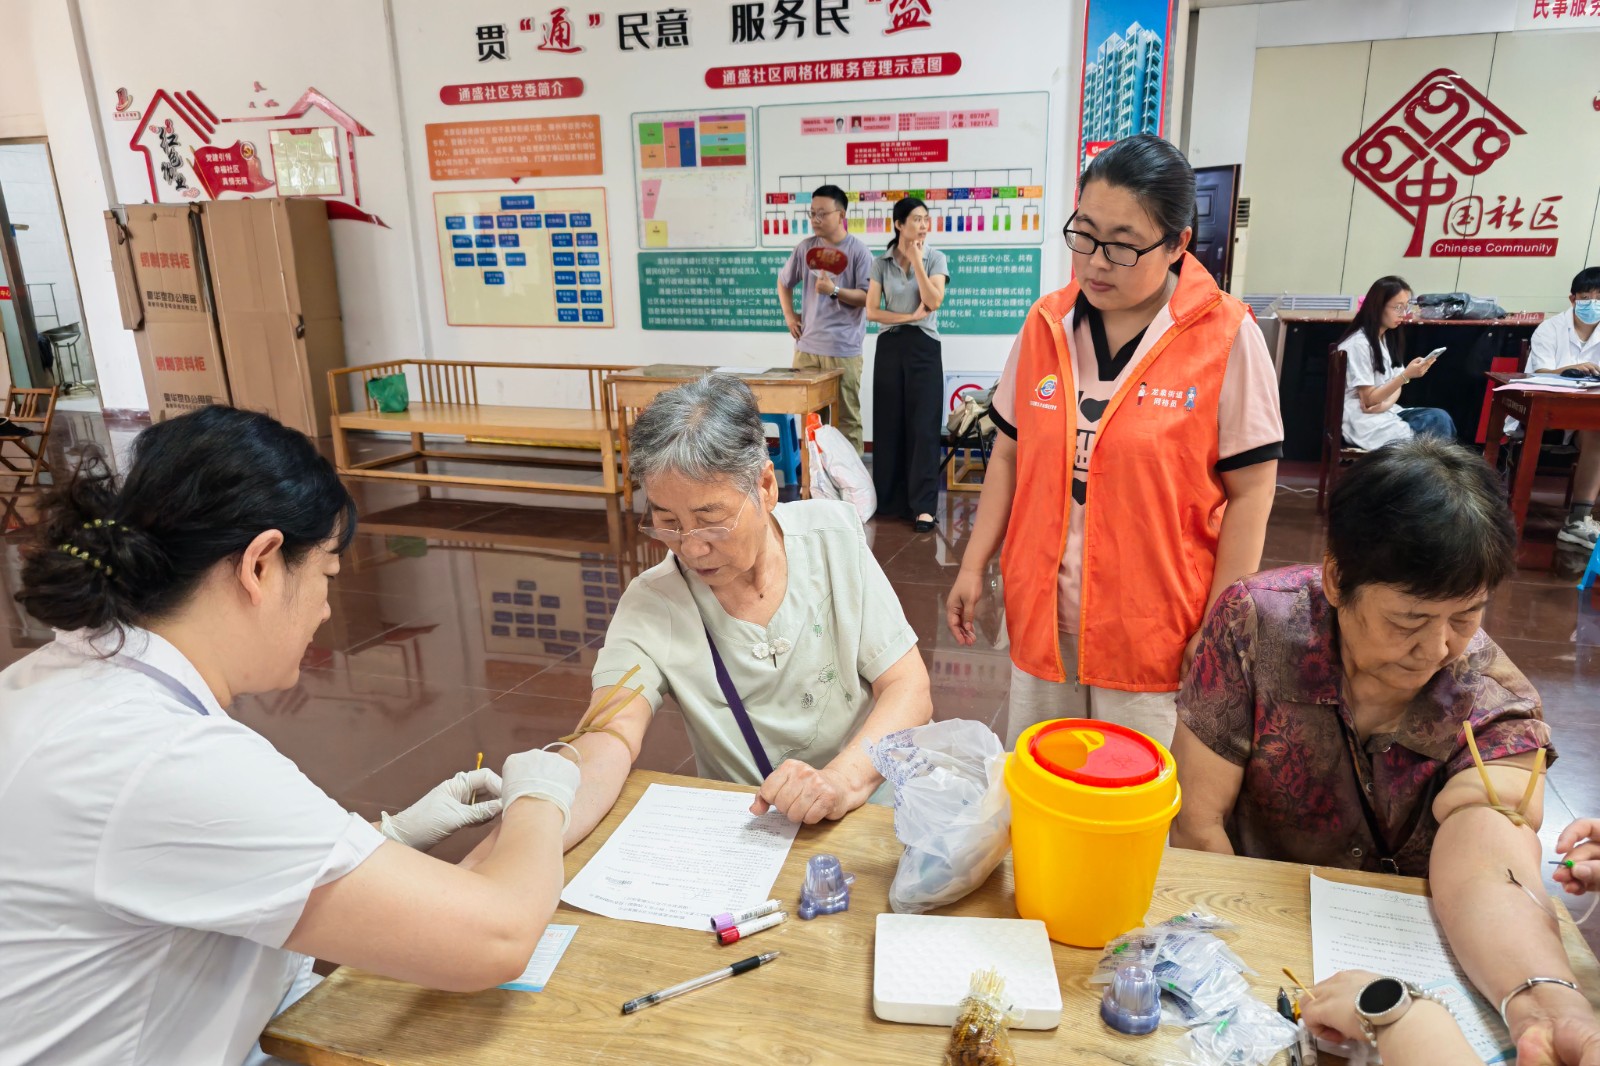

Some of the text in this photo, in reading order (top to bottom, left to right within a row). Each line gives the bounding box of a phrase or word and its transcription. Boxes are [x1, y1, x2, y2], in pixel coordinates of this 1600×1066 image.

[722, 56, 943, 86] 通盛社区网格化服务管理示意图
[459, 81, 564, 102] 通盛社区党委简介
[213, 165, 240, 174] 幸福社区
[1435, 243, 1553, 255] Chinese Community
[1151, 388, 1184, 399] 龙泉街道
[1153, 397, 1178, 408] 网格员
